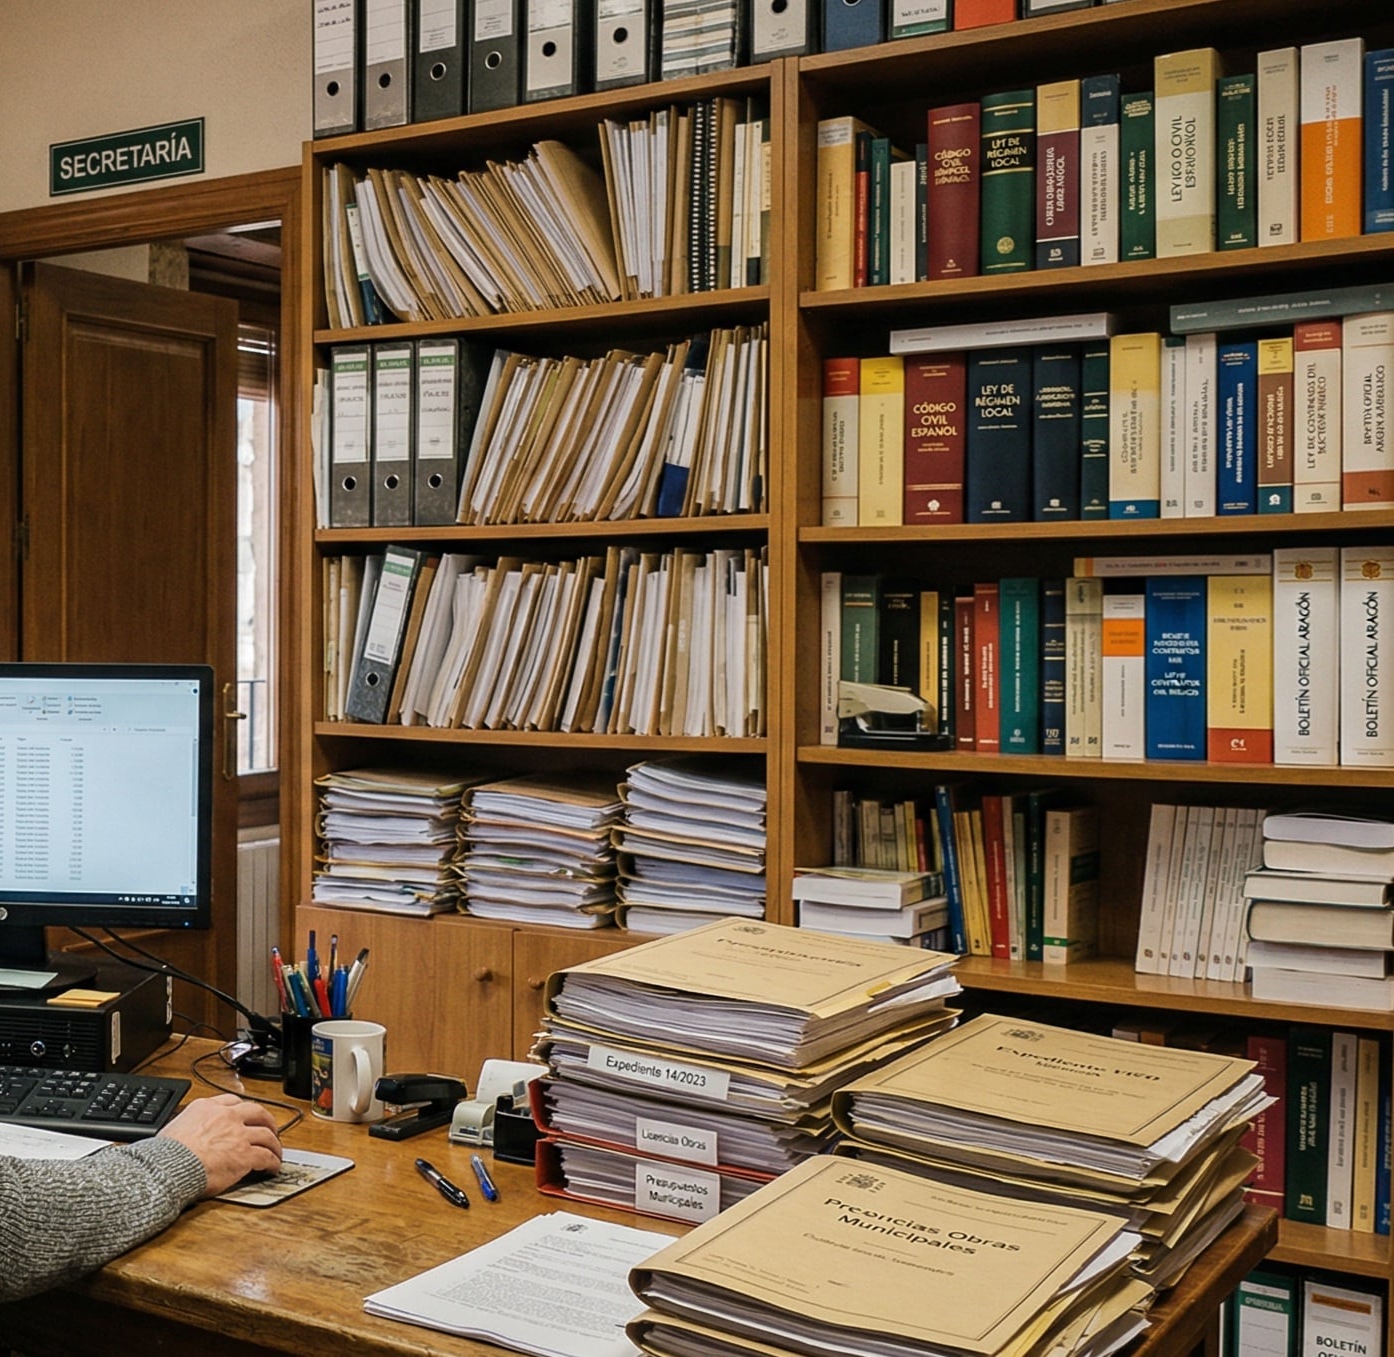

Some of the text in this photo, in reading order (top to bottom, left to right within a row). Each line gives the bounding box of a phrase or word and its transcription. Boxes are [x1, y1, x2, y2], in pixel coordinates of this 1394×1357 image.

[60, 132, 193, 180] SECRETARÍA
[981, 383, 1015, 396] LEY DE
[913, 401, 957, 414] CÓDIGO
[981, 407, 1014, 418] LOCAL
[1295, 591, 1311, 736] BOLETÍN OFICIAL ARAGÓN
[1361, 591, 1379, 738] BOLETÍN OFICIAL ARAGÓN
[666, 1068, 707, 1087] 14/2023
[837, 1213, 977, 1257] Municipales
[948, 1231, 1021, 1253] Obras
[1316, 1335, 1367, 1355] BOLETÍN
